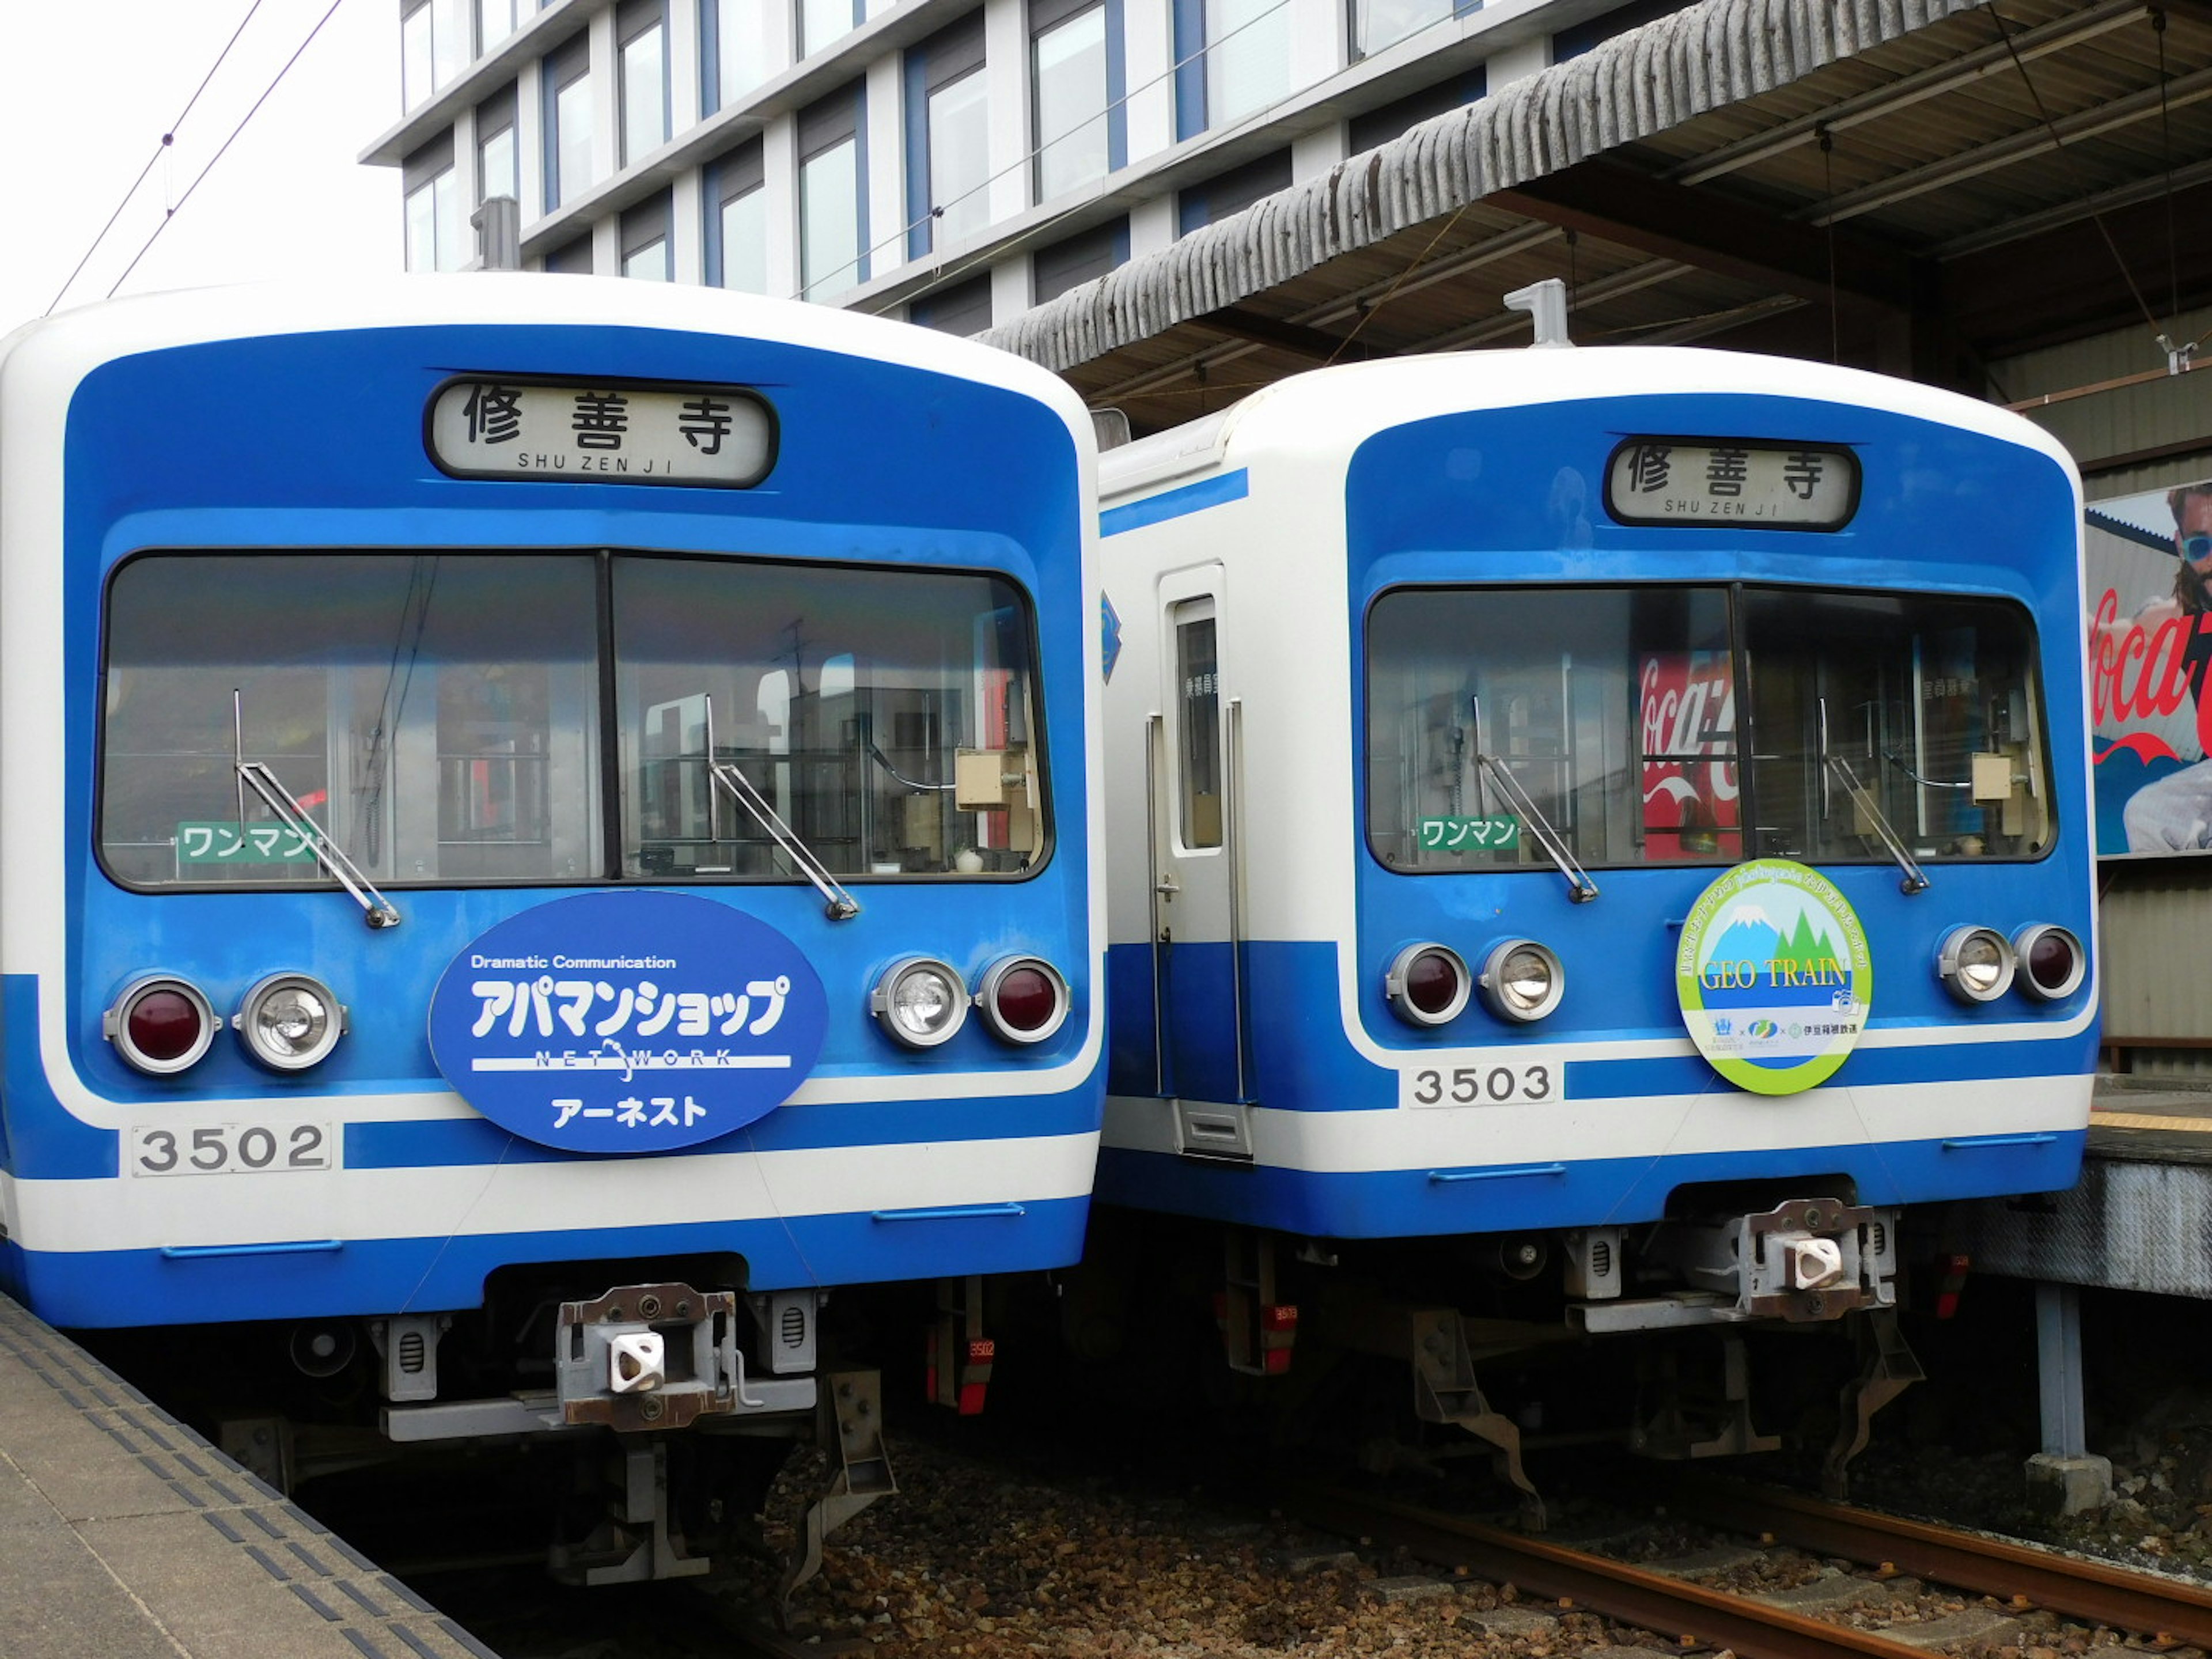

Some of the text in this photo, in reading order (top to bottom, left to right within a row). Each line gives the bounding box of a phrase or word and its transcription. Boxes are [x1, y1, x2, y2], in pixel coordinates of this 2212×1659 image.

[463, 385, 732, 454] 修善寺
[1628, 445, 1823, 499] 修善寺
[184, 827, 313, 857] ワンマン
[1423, 821, 1515, 846] ワンマン
[471, 955, 676, 969] Dramatic Communication
[1700, 957, 1847, 990] GEO TRAIN
[471, 975, 791, 1037] アパマンショップ
[1415, 1066, 1550, 1104] 3503
[551, 1096, 707, 1128] アーネスト
[139, 1125, 324, 1172] 3502
